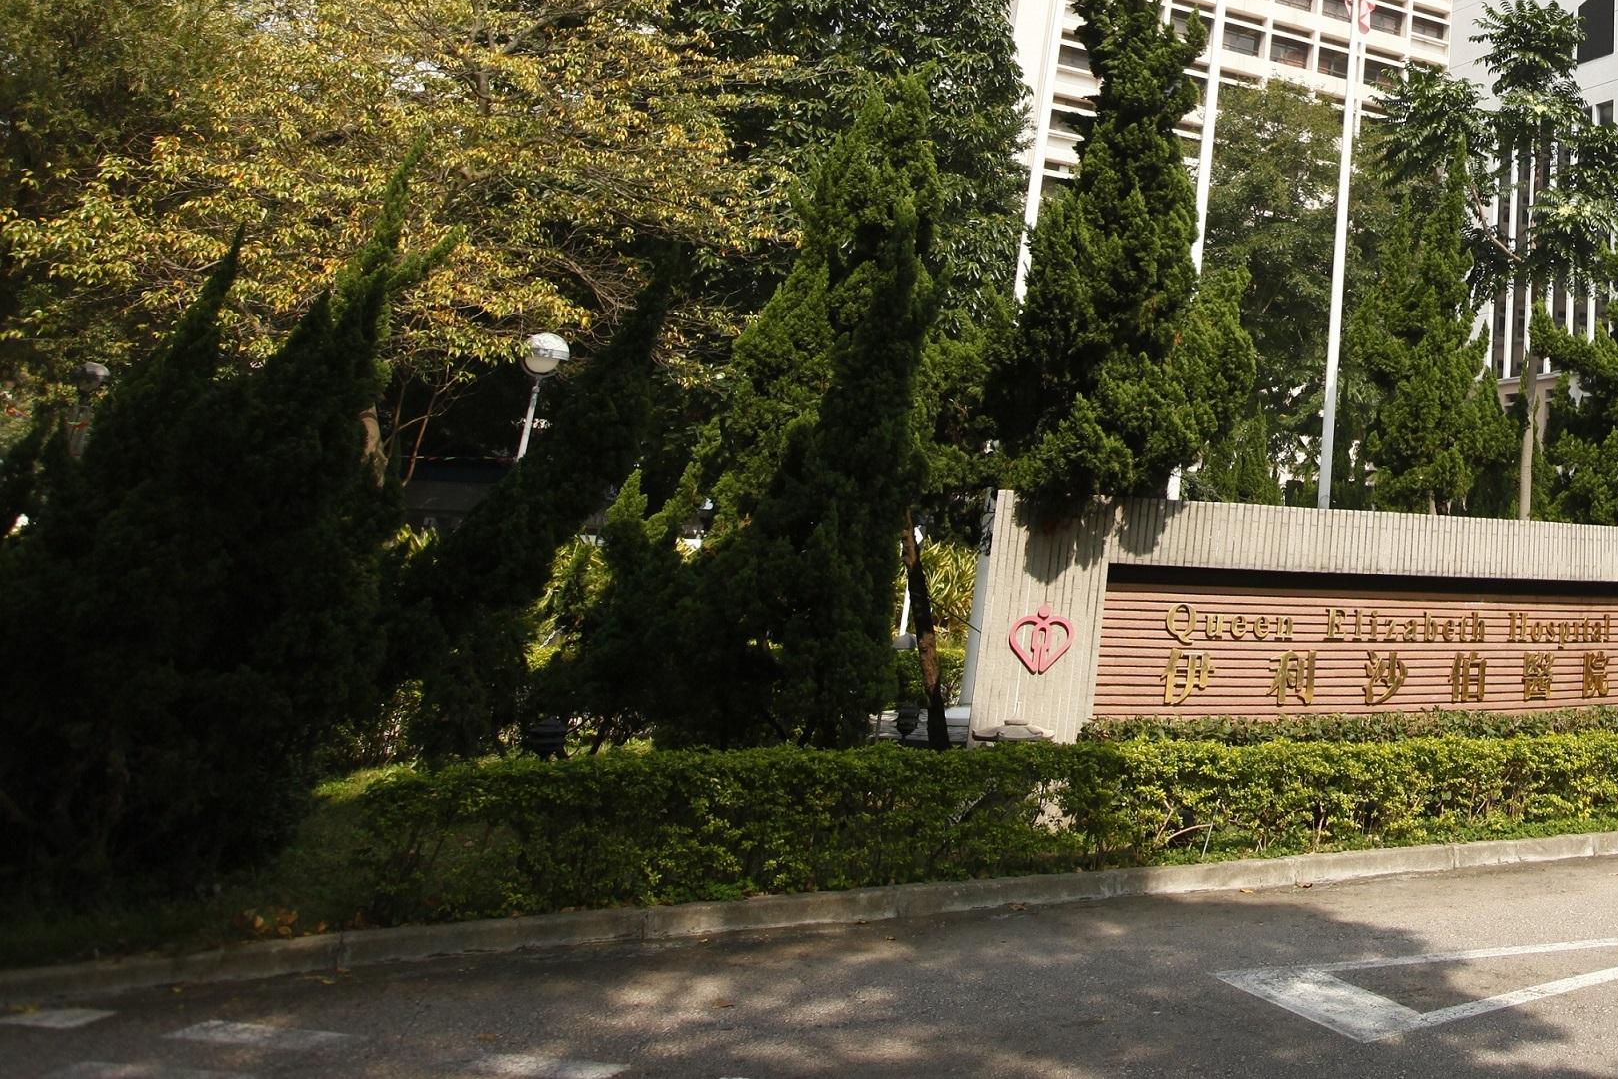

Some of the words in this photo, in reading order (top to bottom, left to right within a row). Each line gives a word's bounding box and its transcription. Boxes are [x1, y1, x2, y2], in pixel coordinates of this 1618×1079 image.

[1165, 603, 1294, 645] Queen
[1323, 608, 1486, 642] Elizabeth
[1507, 612, 1611, 649] Hospital
[1160, 647, 1610, 706] 伊利沙伯醫院
